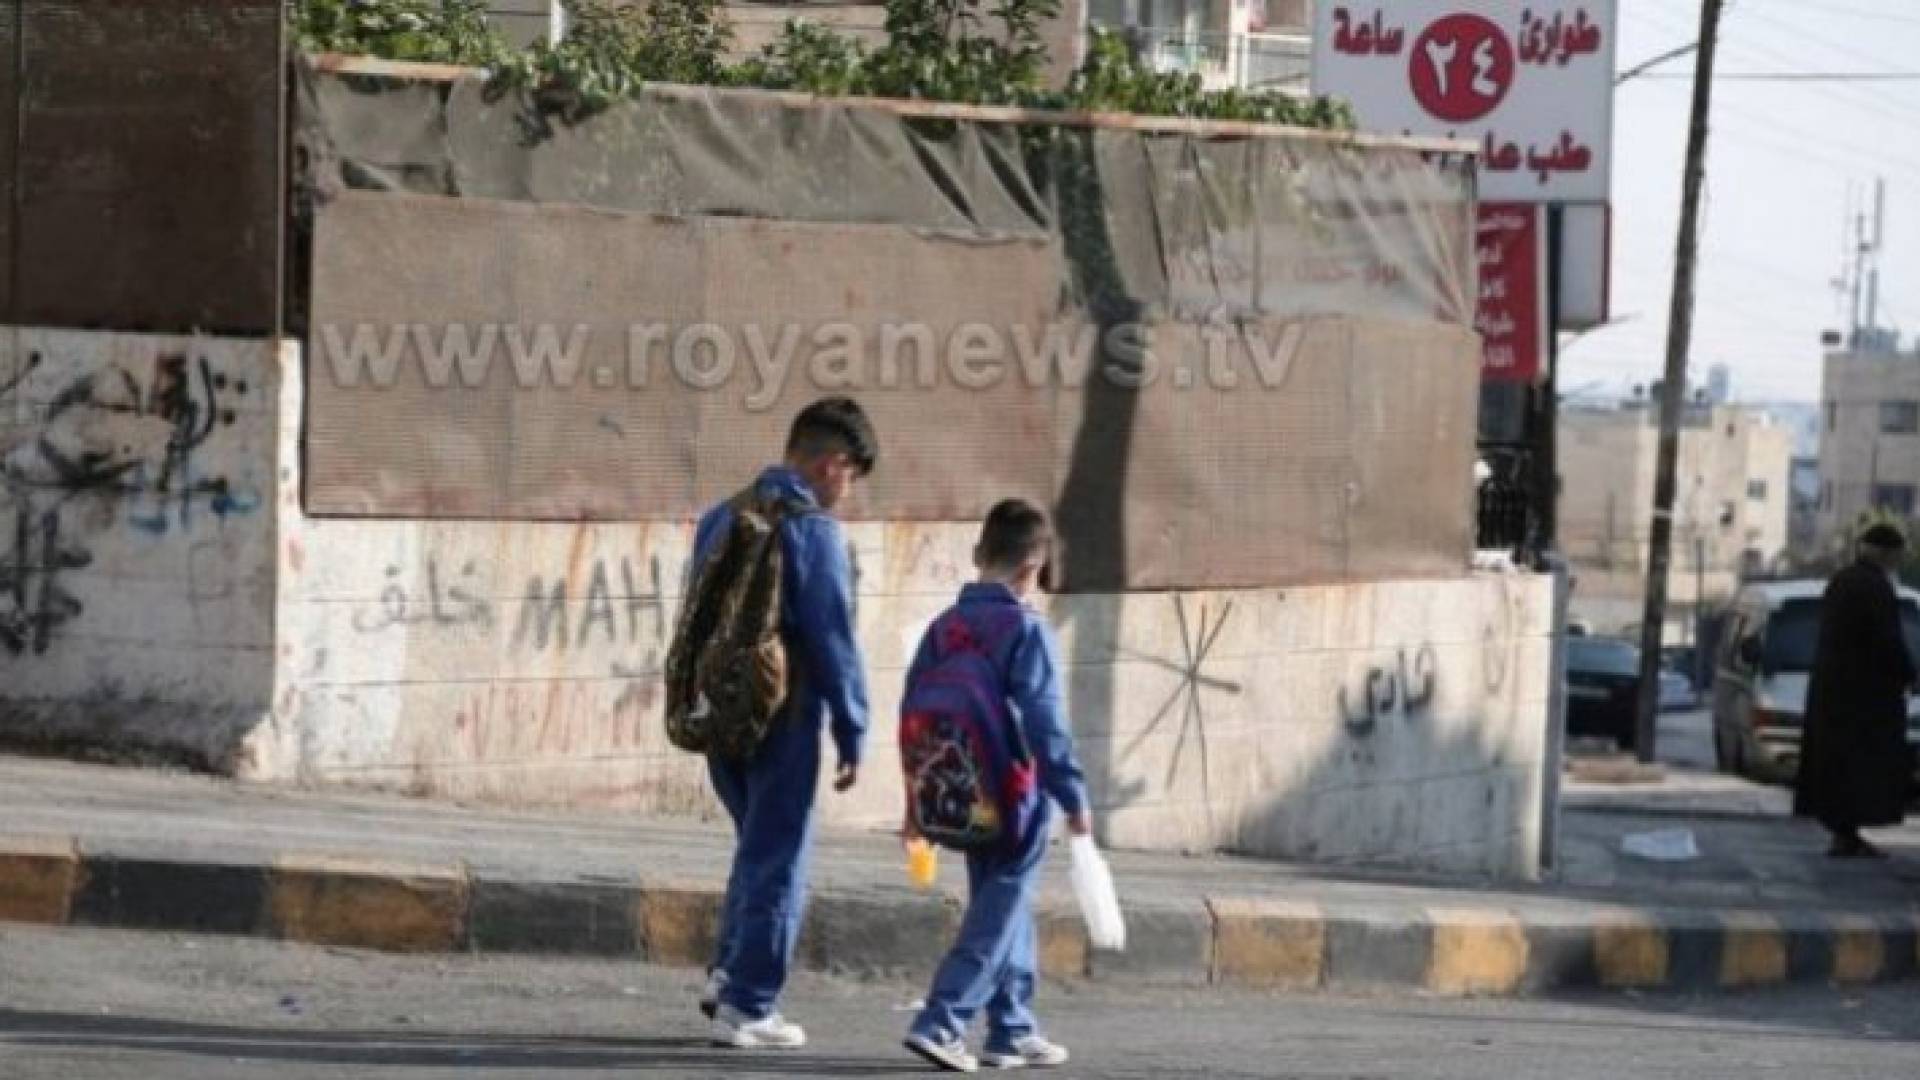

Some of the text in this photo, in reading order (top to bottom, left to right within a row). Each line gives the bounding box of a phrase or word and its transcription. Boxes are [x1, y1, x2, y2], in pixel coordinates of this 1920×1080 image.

[1332, 7, 1601, 97] طوارئ ٢٤ ساعة
[1526, 128, 1592, 185] طب
